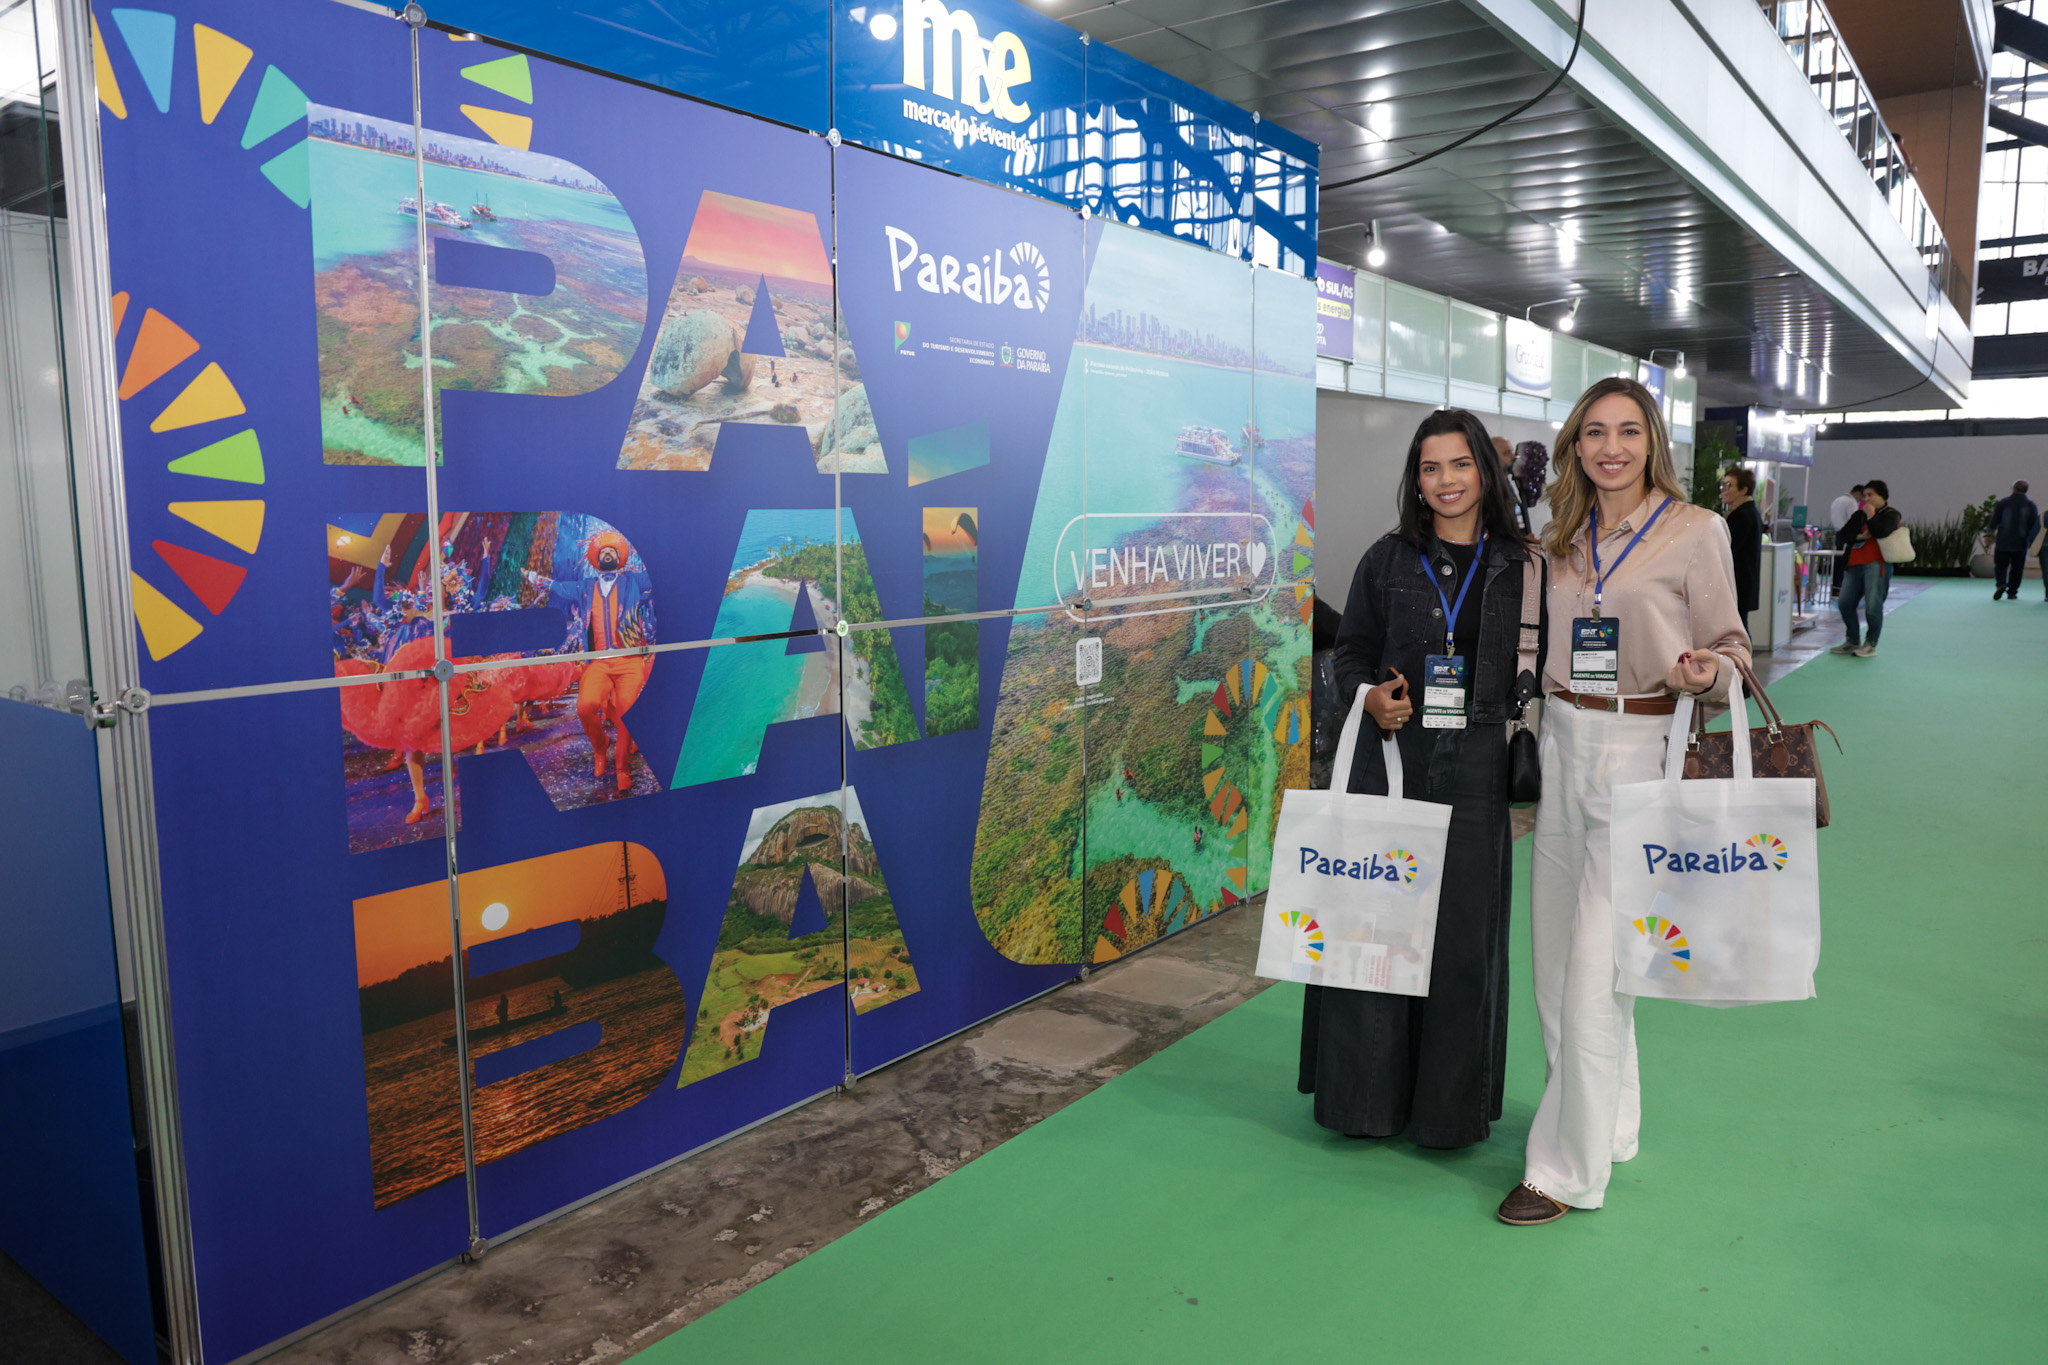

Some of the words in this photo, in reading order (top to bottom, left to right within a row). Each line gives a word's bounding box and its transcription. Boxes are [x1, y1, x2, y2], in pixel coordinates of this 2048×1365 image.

[885, 225, 1033, 309] Paraíba
[1017, 347, 1046, 361] GOVERNO
[1017, 359, 1026, 371] DA
[1070, 545, 1169, 590] VENHA
[1173, 543, 1241, 581] VIVER
[1299, 846, 1400, 882] Paraíba
[1643, 842, 1768, 874] Paraíba
